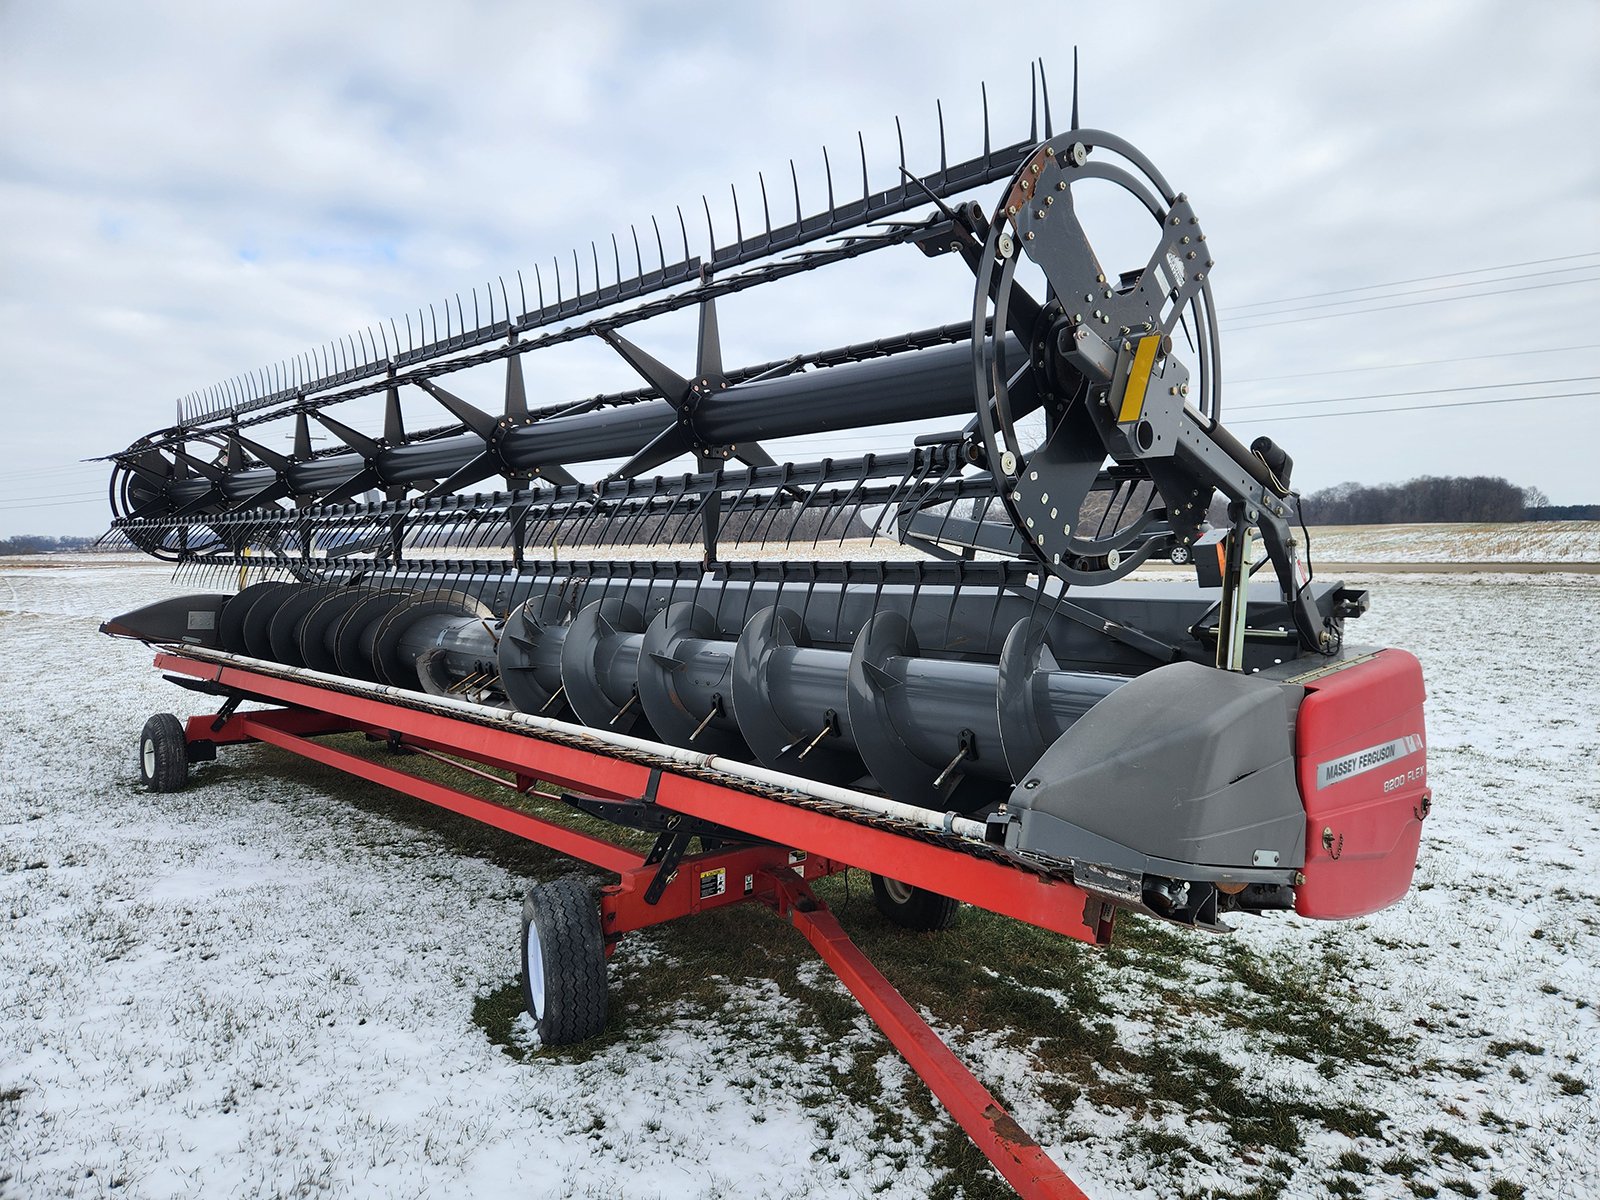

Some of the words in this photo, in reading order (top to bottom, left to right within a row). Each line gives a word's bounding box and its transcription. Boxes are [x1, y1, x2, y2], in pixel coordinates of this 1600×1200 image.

[1326, 758, 1357, 780] MASSEY
[1359, 744, 1395, 768] FERGUSON
[1384, 774, 1404, 792] 8200
[1408, 765, 1424, 781] FLEX
